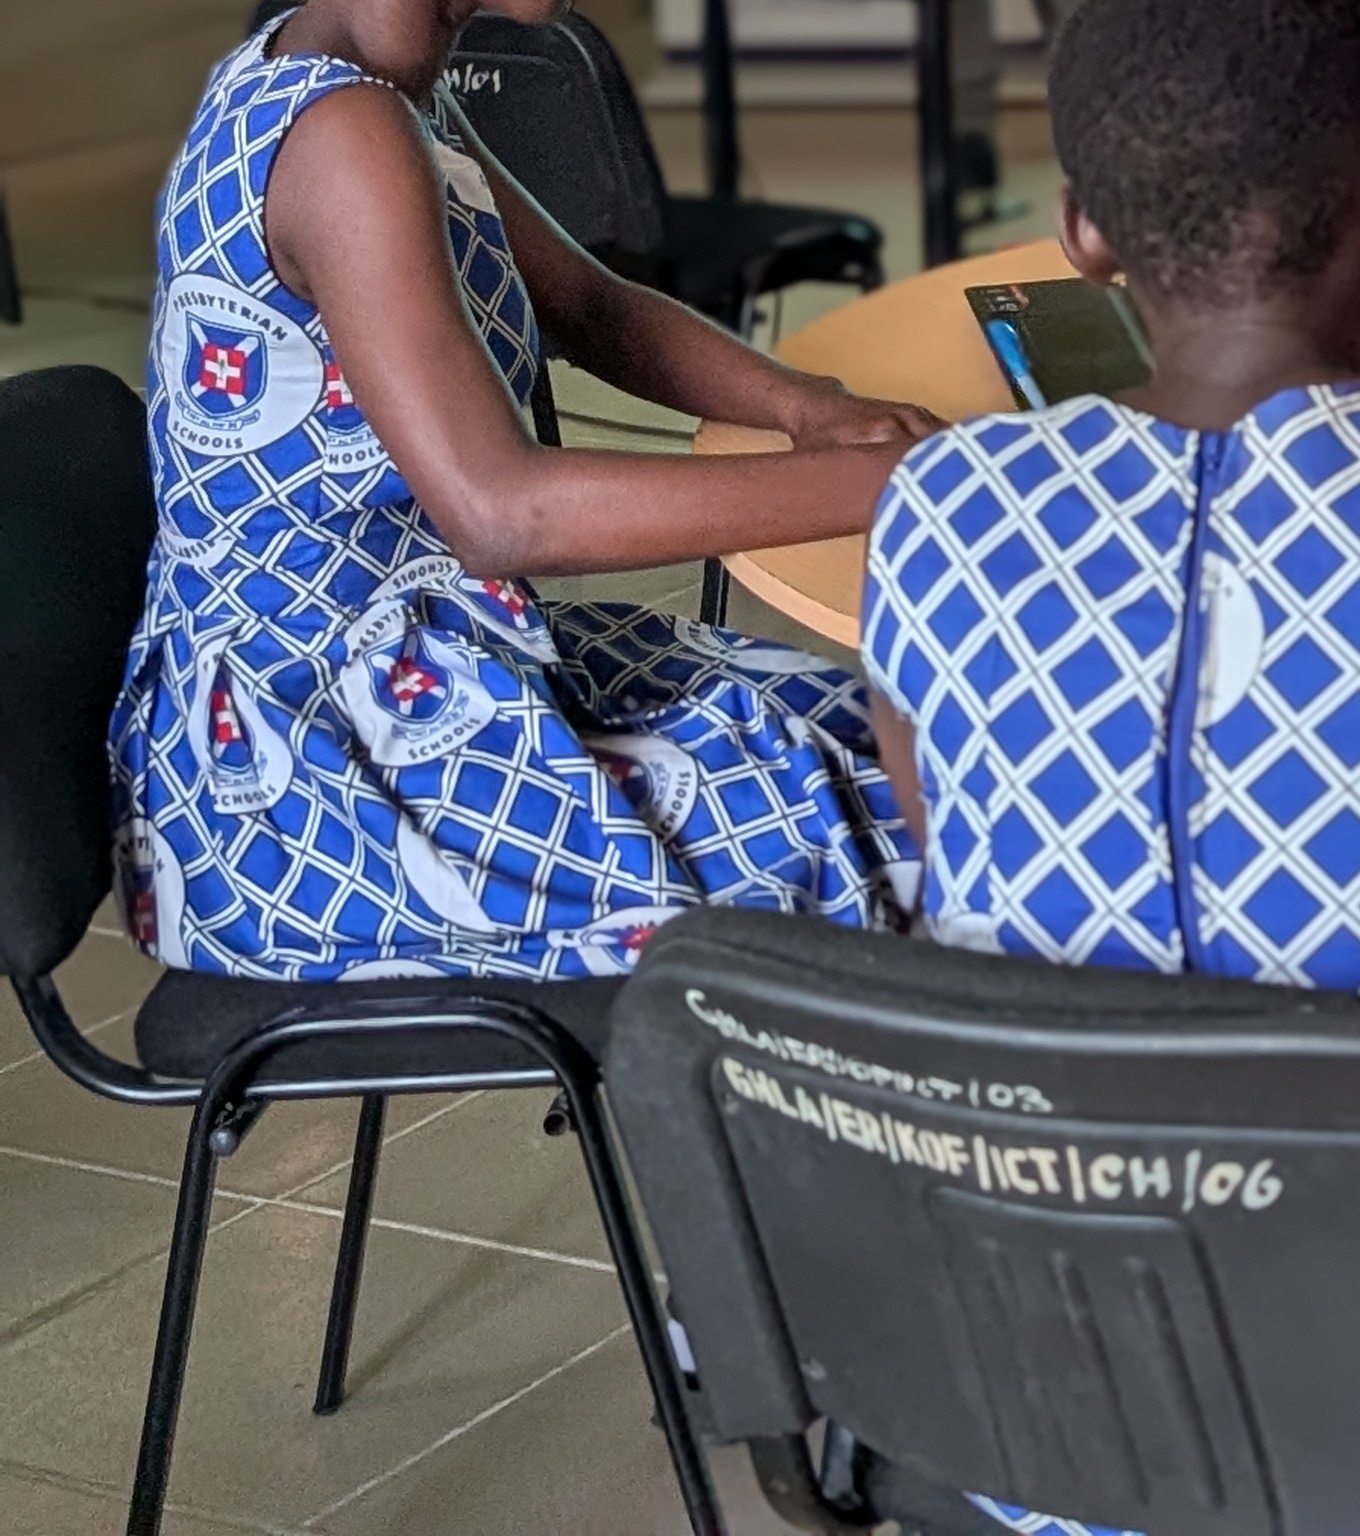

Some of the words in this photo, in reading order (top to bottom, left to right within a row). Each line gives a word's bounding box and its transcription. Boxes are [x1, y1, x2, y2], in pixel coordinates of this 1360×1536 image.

[173, 291, 288, 341] PRESBYTERIAN
[172, 421, 243, 449] SCHOOLS
[408, 717, 481, 760] SCHOOLS
